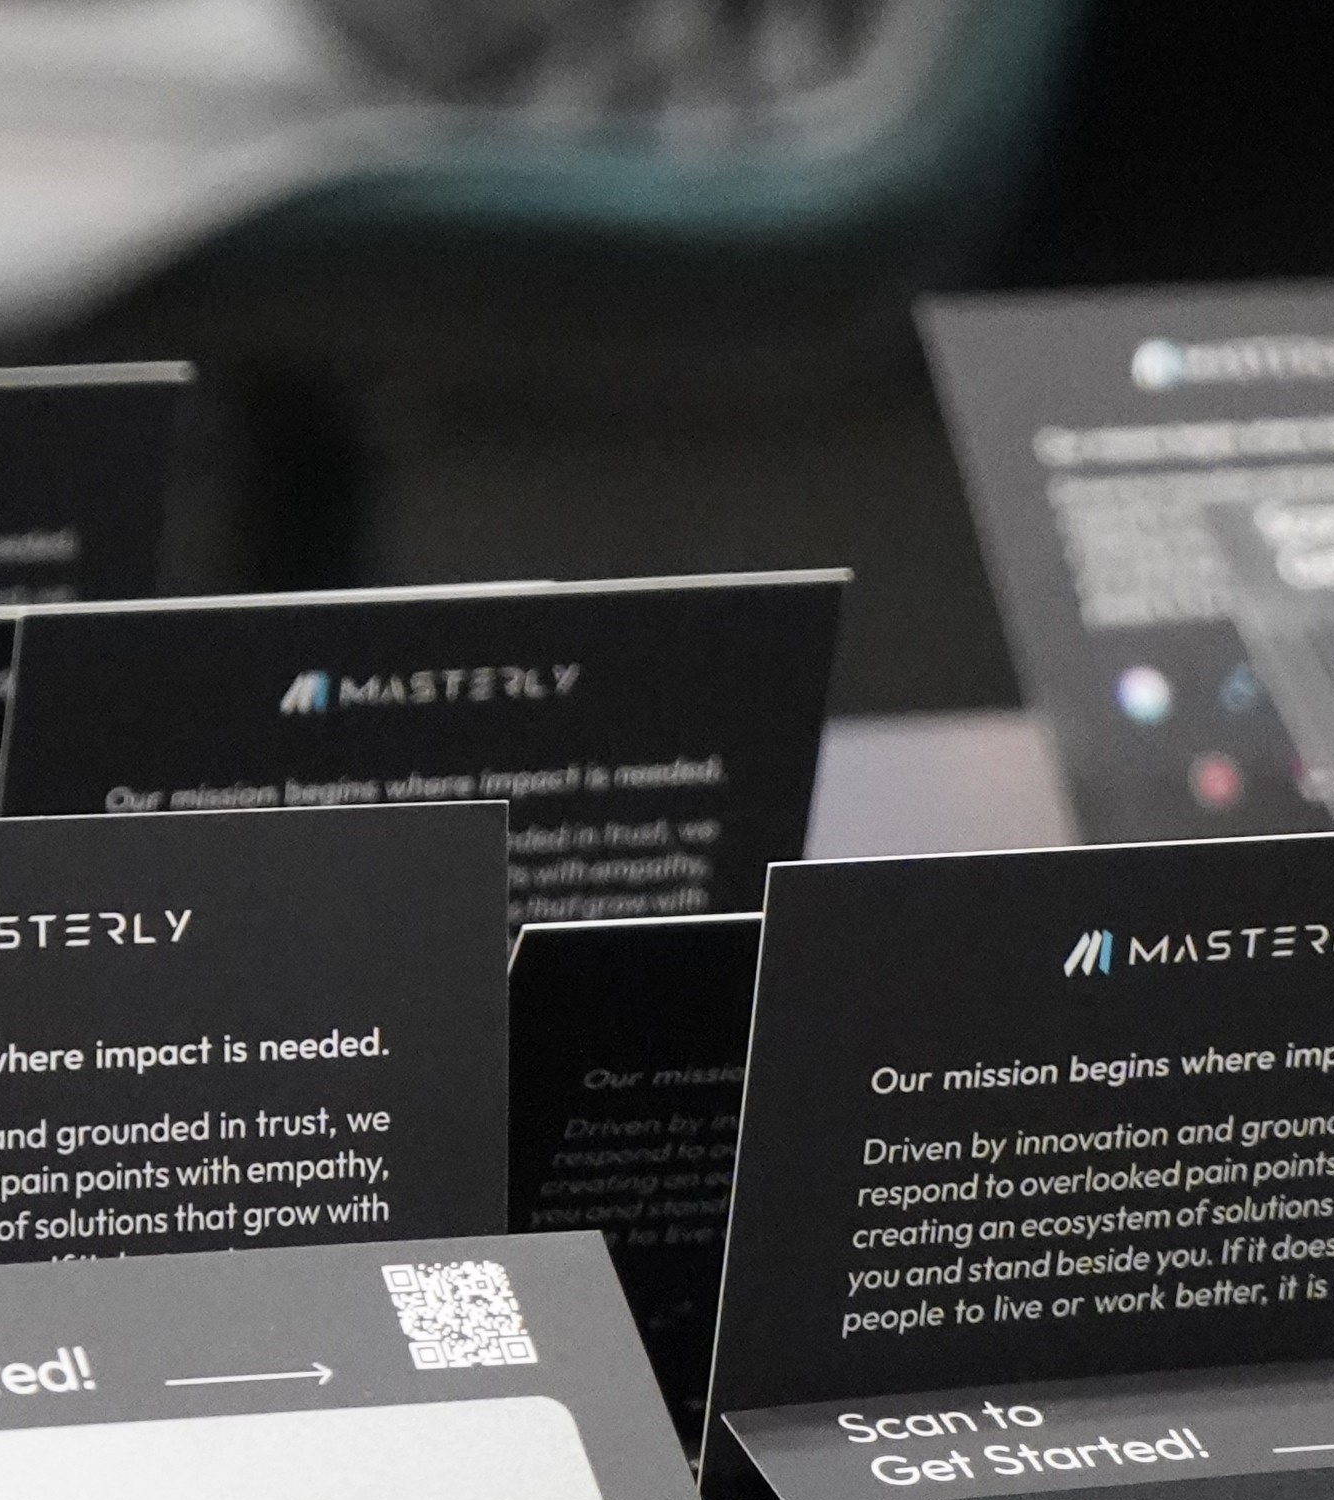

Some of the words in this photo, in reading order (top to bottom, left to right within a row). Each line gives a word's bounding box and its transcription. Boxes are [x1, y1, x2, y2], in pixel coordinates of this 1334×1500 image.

[338, 662, 581, 705] MASTERLY
[97, 1036, 212, 1074] impact
[224, 1036, 247, 1062] is
[260, 1027, 389, 1061] needed.
[872, 1067, 932, 1094] Our
[944, 1065, 1058, 1090] mission
[1070, 1056, 1169, 1087] begins
[1182, 1047, 1275, 1074] where
[57, 1112, 209, 1155] grounded
[221, 1111, 246, 1139] in
[256, 1107, 336, 1138] trust,
[347, 1111, 390, 1132] we
[864, 1139, 961, 1165] Driven
[972, 1132, 1007, 1163] by
[1016, 1124, 1168, 1155] innovation
[1177, 1115, 1234, 1145] and
[1, 1173, 68, 1202] pain
[76, 1161, 169, 1198] points
[176, 1156, 240, 1186] with
[247, 1150, 388, 1187] empathy,
[858, 1173, 979, 1210] respond
[985, 1174, 1014, 1198] to
[1020, 1160, 1181, 1196] overlooked
[1185, 1163, 1248, 1191] pain
[35, 1209, 168, 1239] solutions
[174, 1202, 237, 1231] that
[244, 1205, 320, 1236] grow
[327, 1193, 389, 1223] with
[853, 1220, 973, 1249] creating
[979, 1221, 1015, 1240] an
[1021, 1206, 1171, 1239] ecosystem
[1176, 1198, 1210, 1227] of
[1212, 1196, 1333, 1224] solutions
[849, 1270, 900, 1297] you
[906, 1257, 963, 1286] and
[968, 1251, 1051, 1282] stand
[1056, 1245, 1150, 1276] beside
[1157, 1248, 1212, 1275] you.
[1222, 1237, 1245, 1264] If
[1248, 1237, 1267, 1262] it
[842, 1300, 944, 1338] people
[955, 1299, 984, 1323] to
[994, 1295, 1042, 1321] live
[1052, 1297, 1085, 1317] or
[1095, 1284, 1165, 1313] work
[1176, 1280, 1267, 1308] better,
[1279, 1275, 1298, 1300] it
[1307, 1273, 1327, 1298] is
[838, 1412, 978, 1443] Scan
[982, 1402, 1044, 1429] to
[871, 1450, 974, 1485] Get
[984, 1428, 1209, 1475] Started!
